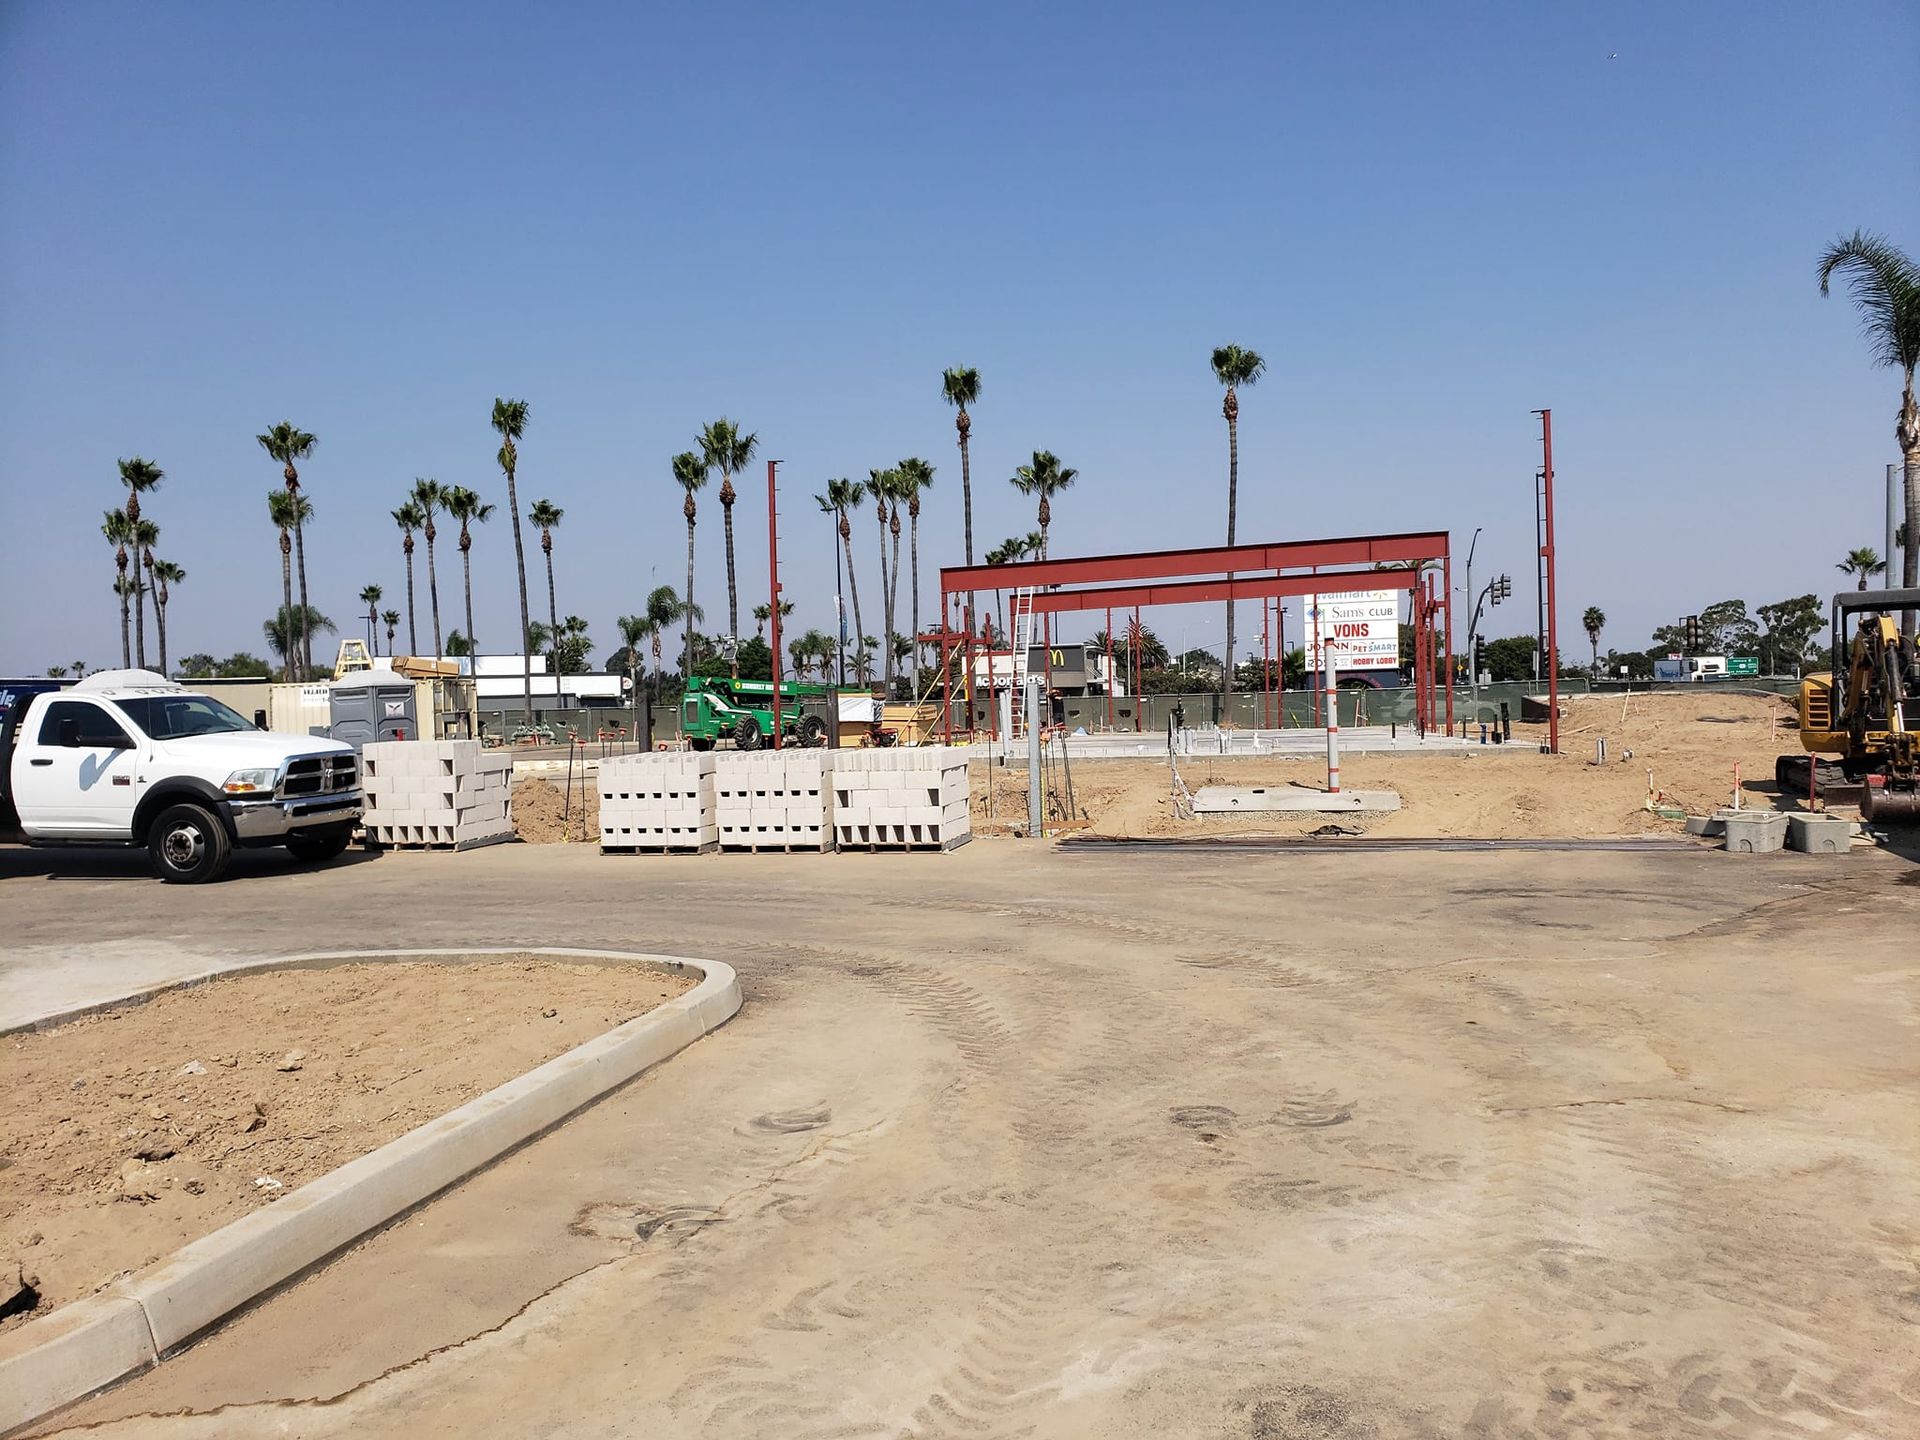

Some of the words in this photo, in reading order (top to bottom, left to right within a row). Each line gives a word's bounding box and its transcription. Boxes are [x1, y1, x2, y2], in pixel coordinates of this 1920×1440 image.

[1332, 606, 1364, 619] Sam's
[1369, 608, 1393, 617] CLUB
[1333, 623, 1369, 638] VONS
